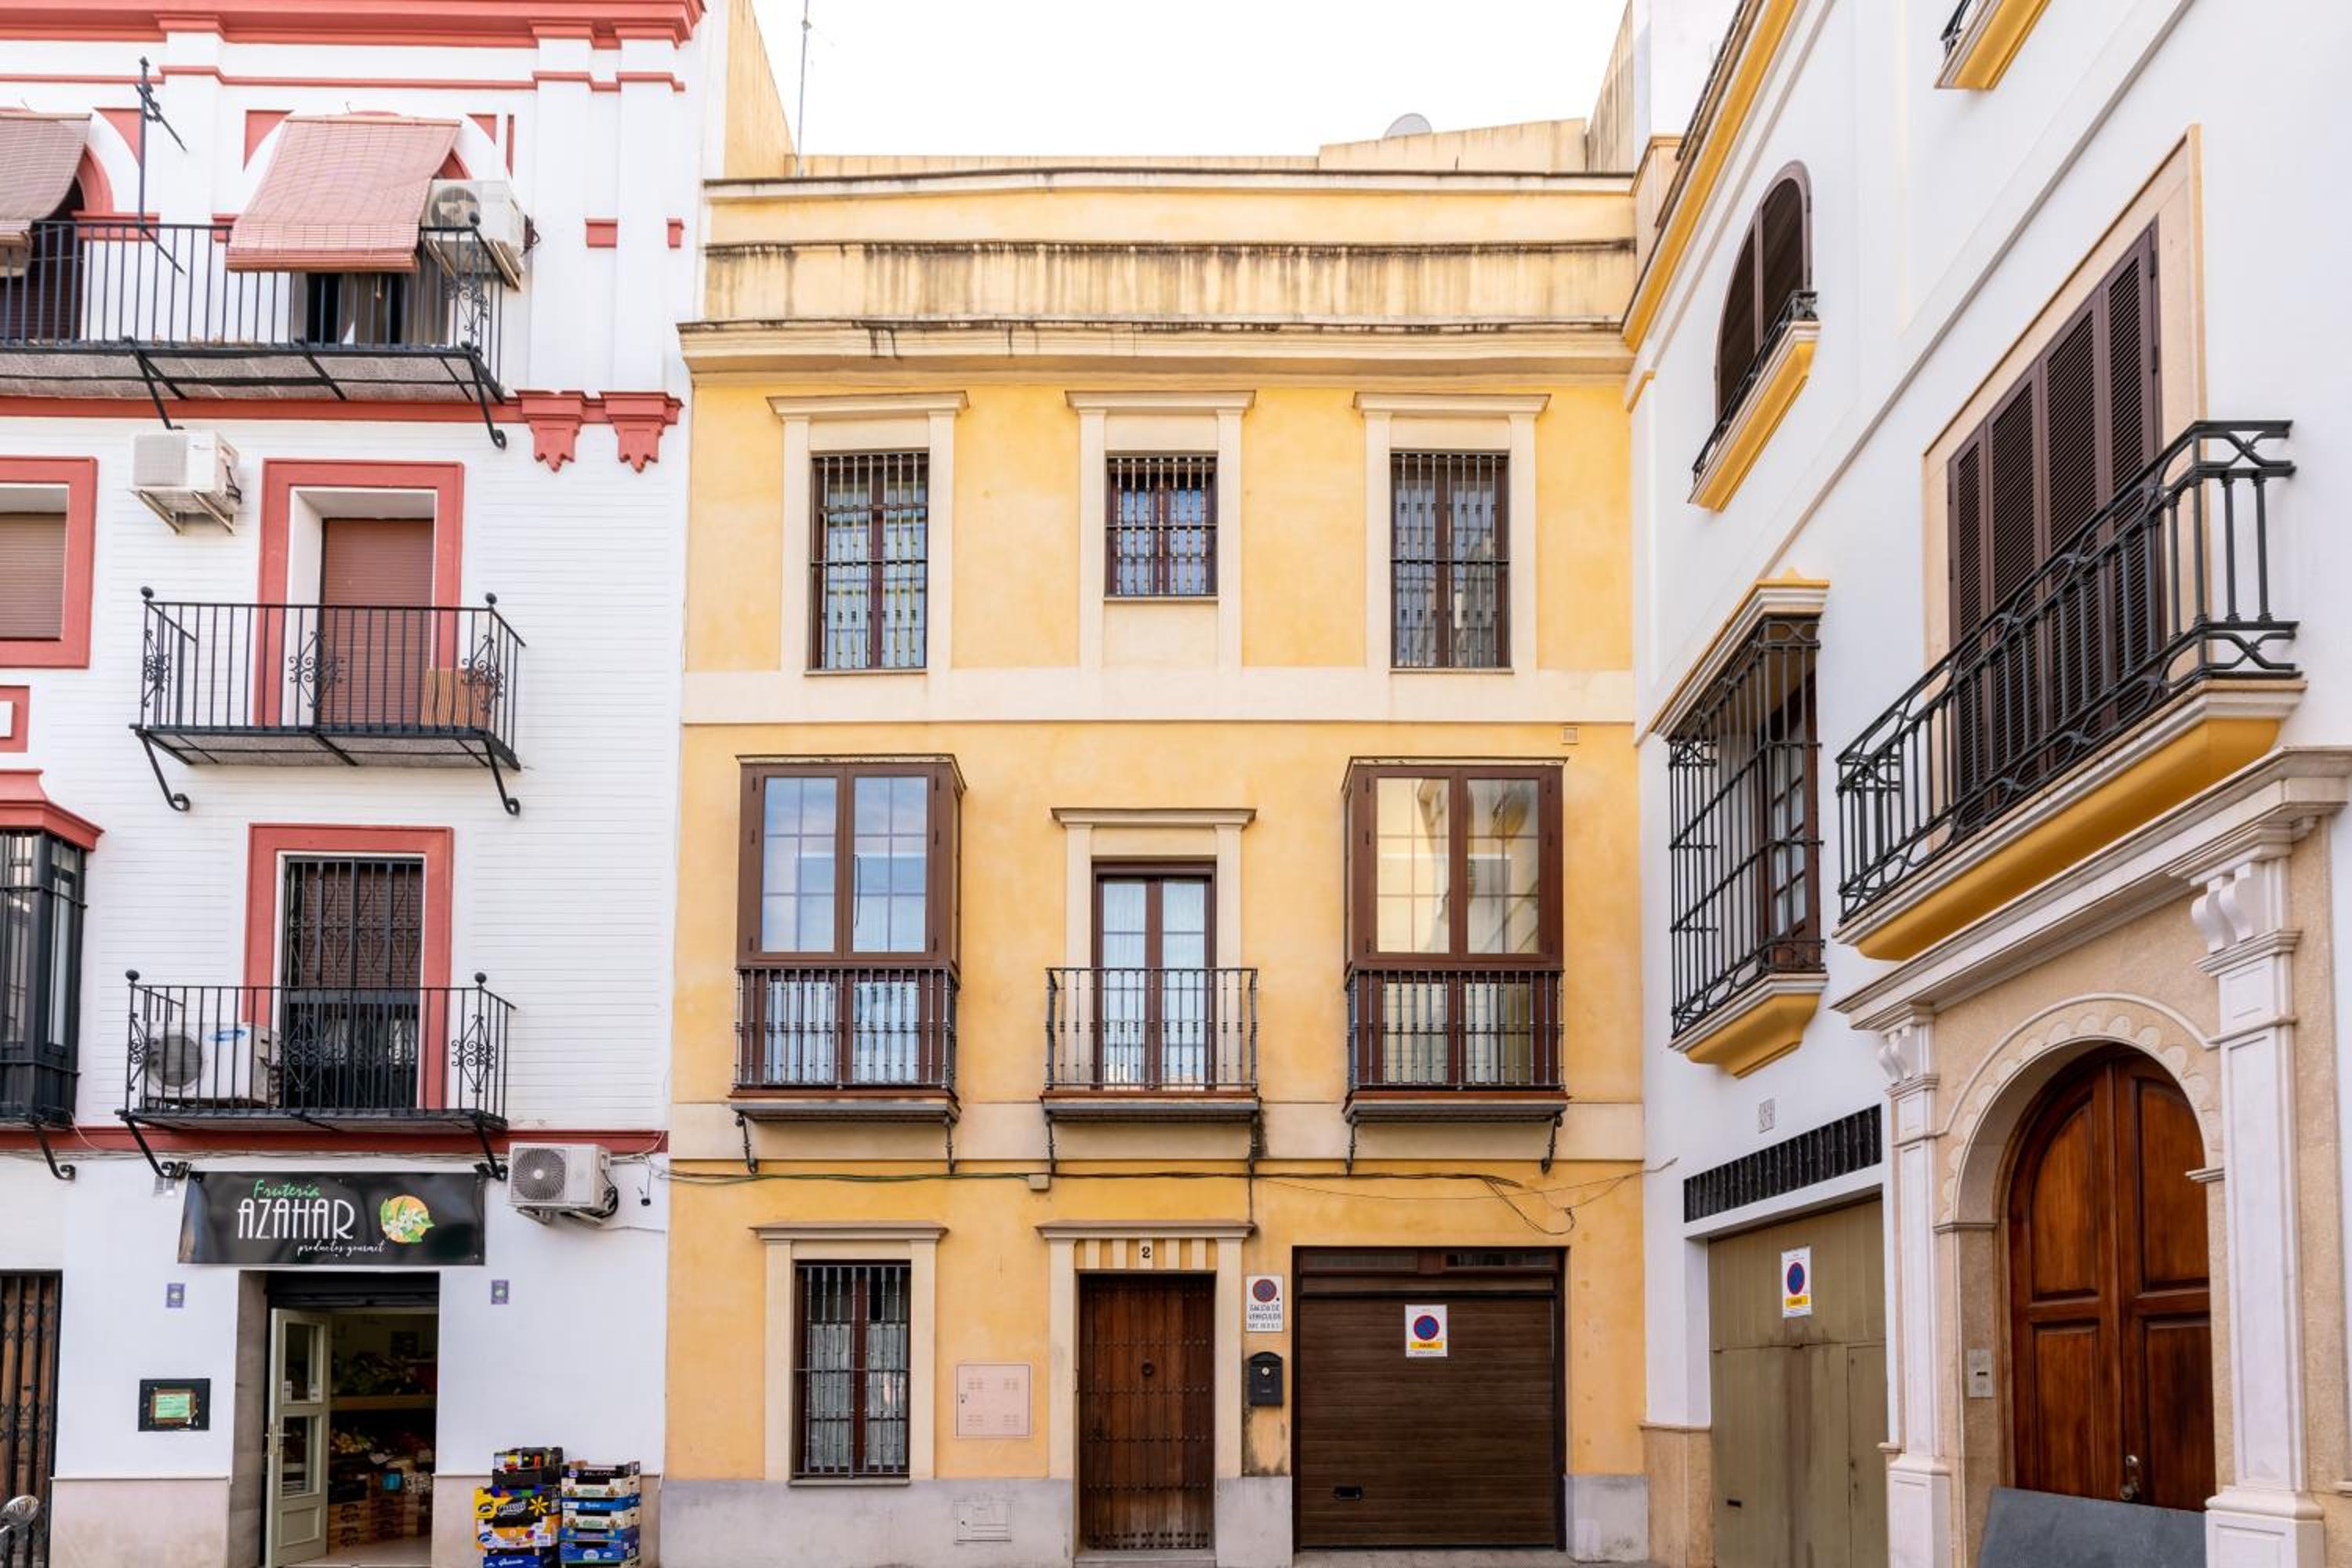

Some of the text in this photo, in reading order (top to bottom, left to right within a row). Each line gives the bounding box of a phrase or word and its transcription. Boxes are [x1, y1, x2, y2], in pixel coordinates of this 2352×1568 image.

[238, 1198, 355, 1240] AZAHAR
[297, 1240, 385, 1257] productos gourmet
[1142, 1246, 1150, 1258] 2
